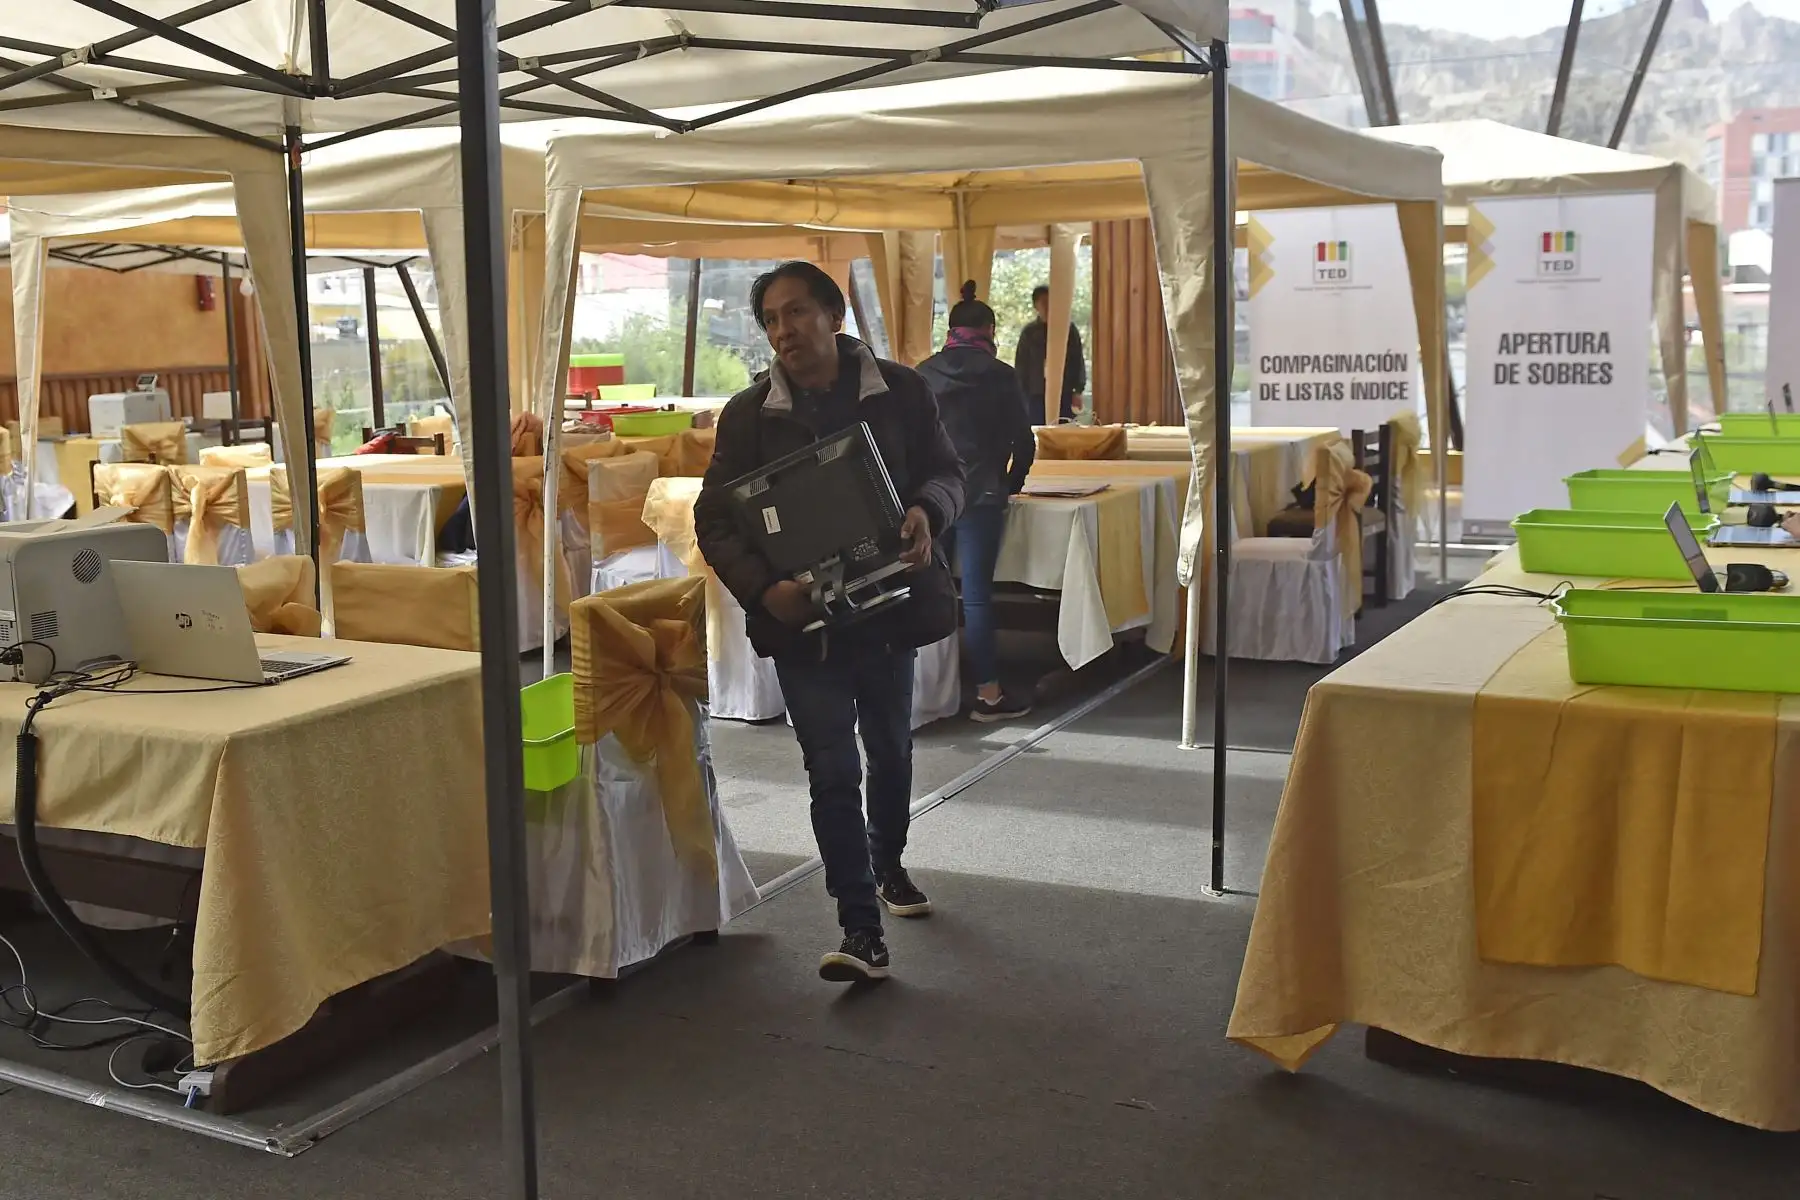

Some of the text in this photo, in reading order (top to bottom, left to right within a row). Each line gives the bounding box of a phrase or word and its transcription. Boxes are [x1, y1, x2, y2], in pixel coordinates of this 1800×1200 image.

[1317, 268, 1347, 279] TED
[1541, 259, 1575, 271] TED
[1498, 331, 1611, 355] APERTURA
[1260, 349, 1408, 374] COMPAGINACIÓN
[1494, 362, 1614, 385] DE SOBRES
[1259, 377, 1409, 401] DE LISTAS ÍNDICE
